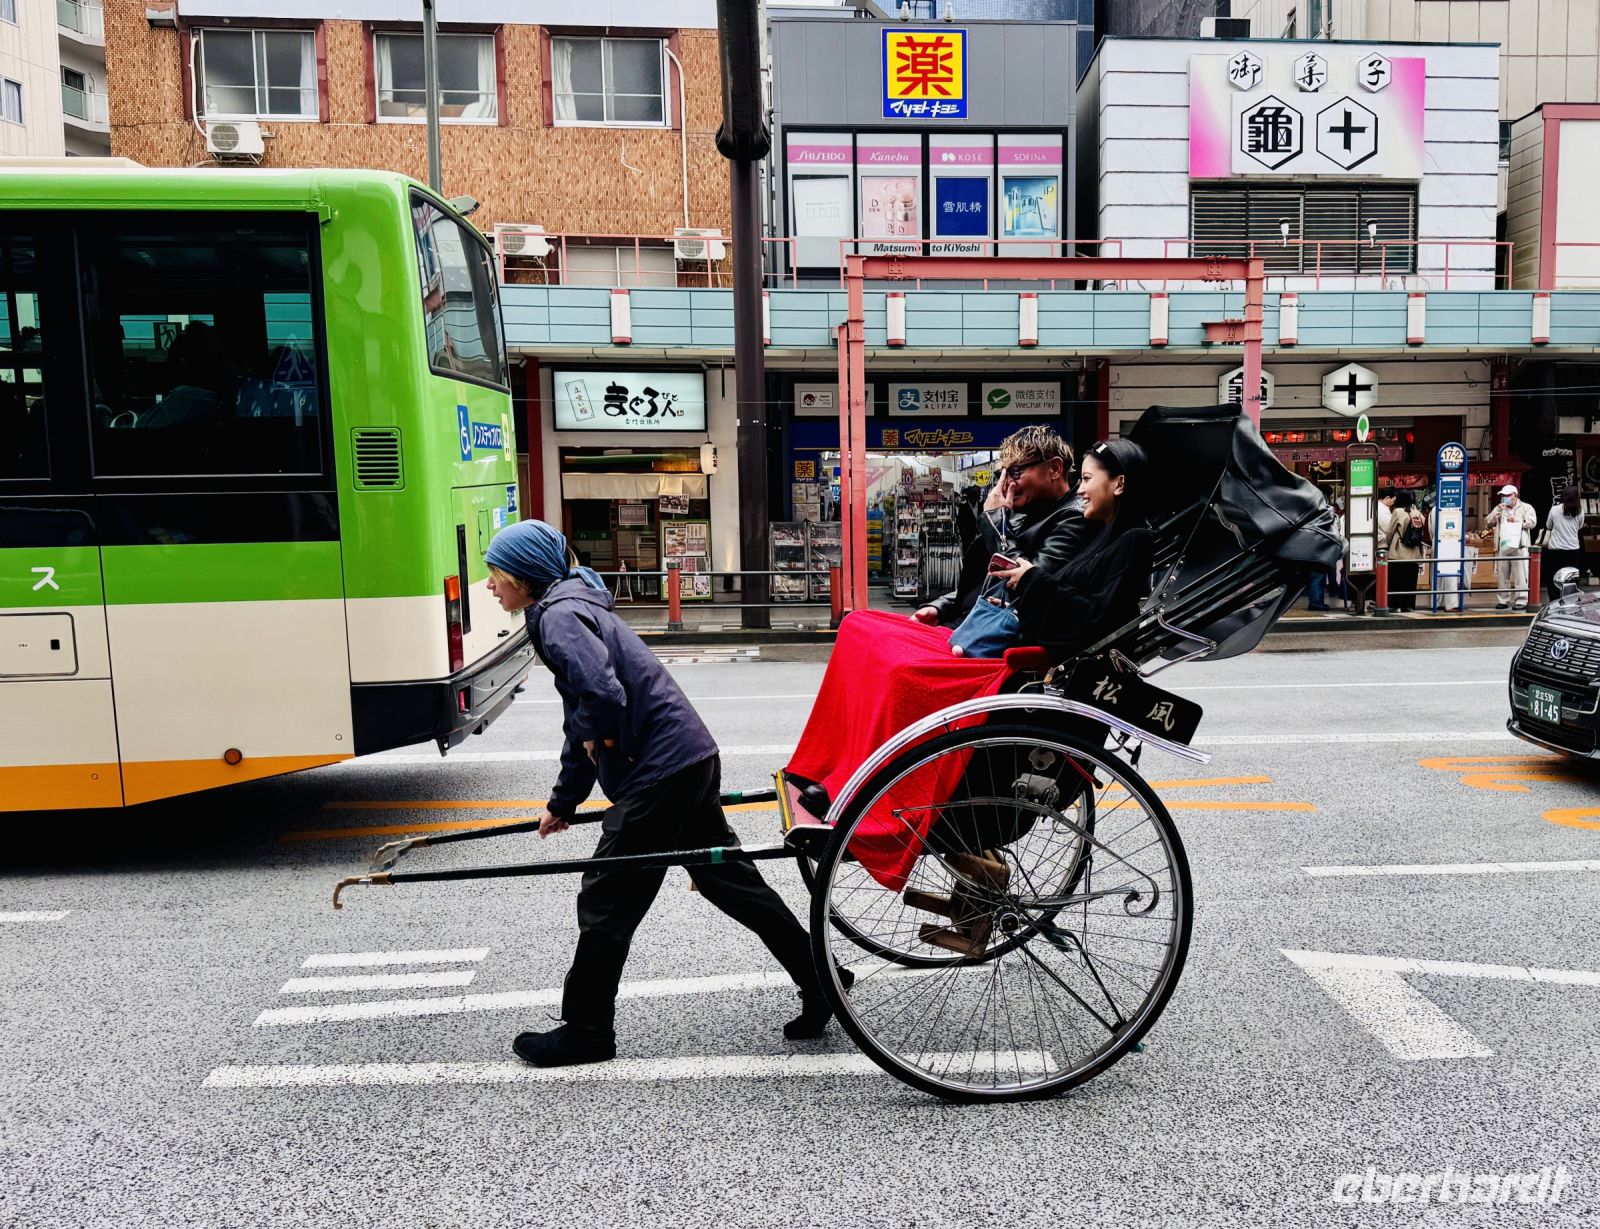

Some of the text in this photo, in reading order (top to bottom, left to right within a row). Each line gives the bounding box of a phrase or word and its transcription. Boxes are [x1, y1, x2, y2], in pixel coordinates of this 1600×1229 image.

[896, 35, 953, 96] 薬
[890, 100, 960, 117] マツモトキヨシ
[795, 151, 846, 161] SHISEIDO
[870, 152, 909, 161] Kanebo
[958, 152, 982, 161] KOSÉ
[1013, 153, 1046, 161] SOFINA
[942, 201, 982, 213] 雪肌精
[603, 381, 676, 417] まぐろ人
[923, 390, 958, 402] 支付宝
[1015, 389, 1055, 400] 微信支付
[1015, 401, 1042, 409] WeChat
[904, 429, 973, 446] マツモトキヨシ
[1443, 450, 1461, 460] 17-2
[31, 566, 60, 591] ス
[1534, 700, 1559, 721] 81-45
